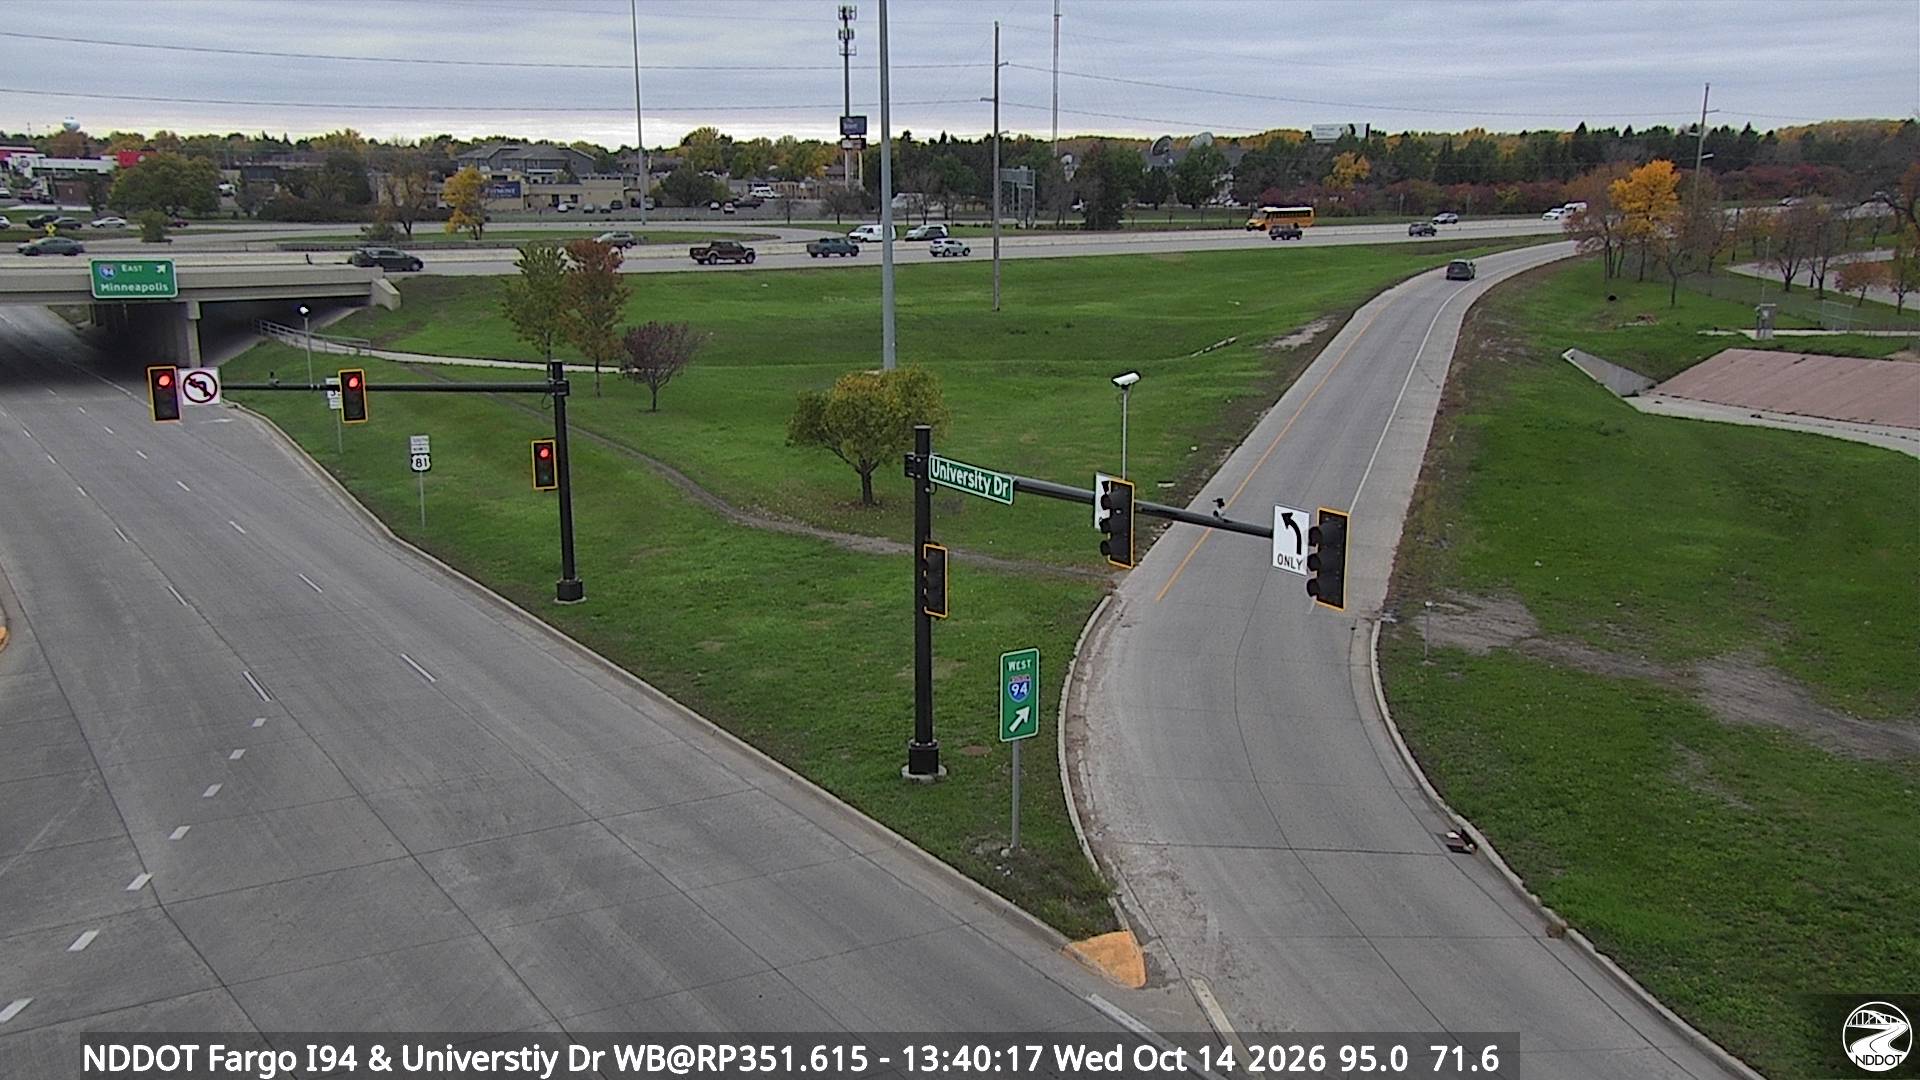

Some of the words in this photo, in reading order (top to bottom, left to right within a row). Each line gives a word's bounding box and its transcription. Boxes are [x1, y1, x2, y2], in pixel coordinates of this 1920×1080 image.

[121, 264, 142, 272] EAST
[100, 282, 169, 293] Minneapolis
[416, 457, 427, 468] 81
[932, 459, 991, 496] University
[994, 475, 1009, 497] Dr
[1277, 553, 1303, 571] ONLY
[1008, 659, 1031, 672] WEST
[1011, 682, 1028, 697] 94
